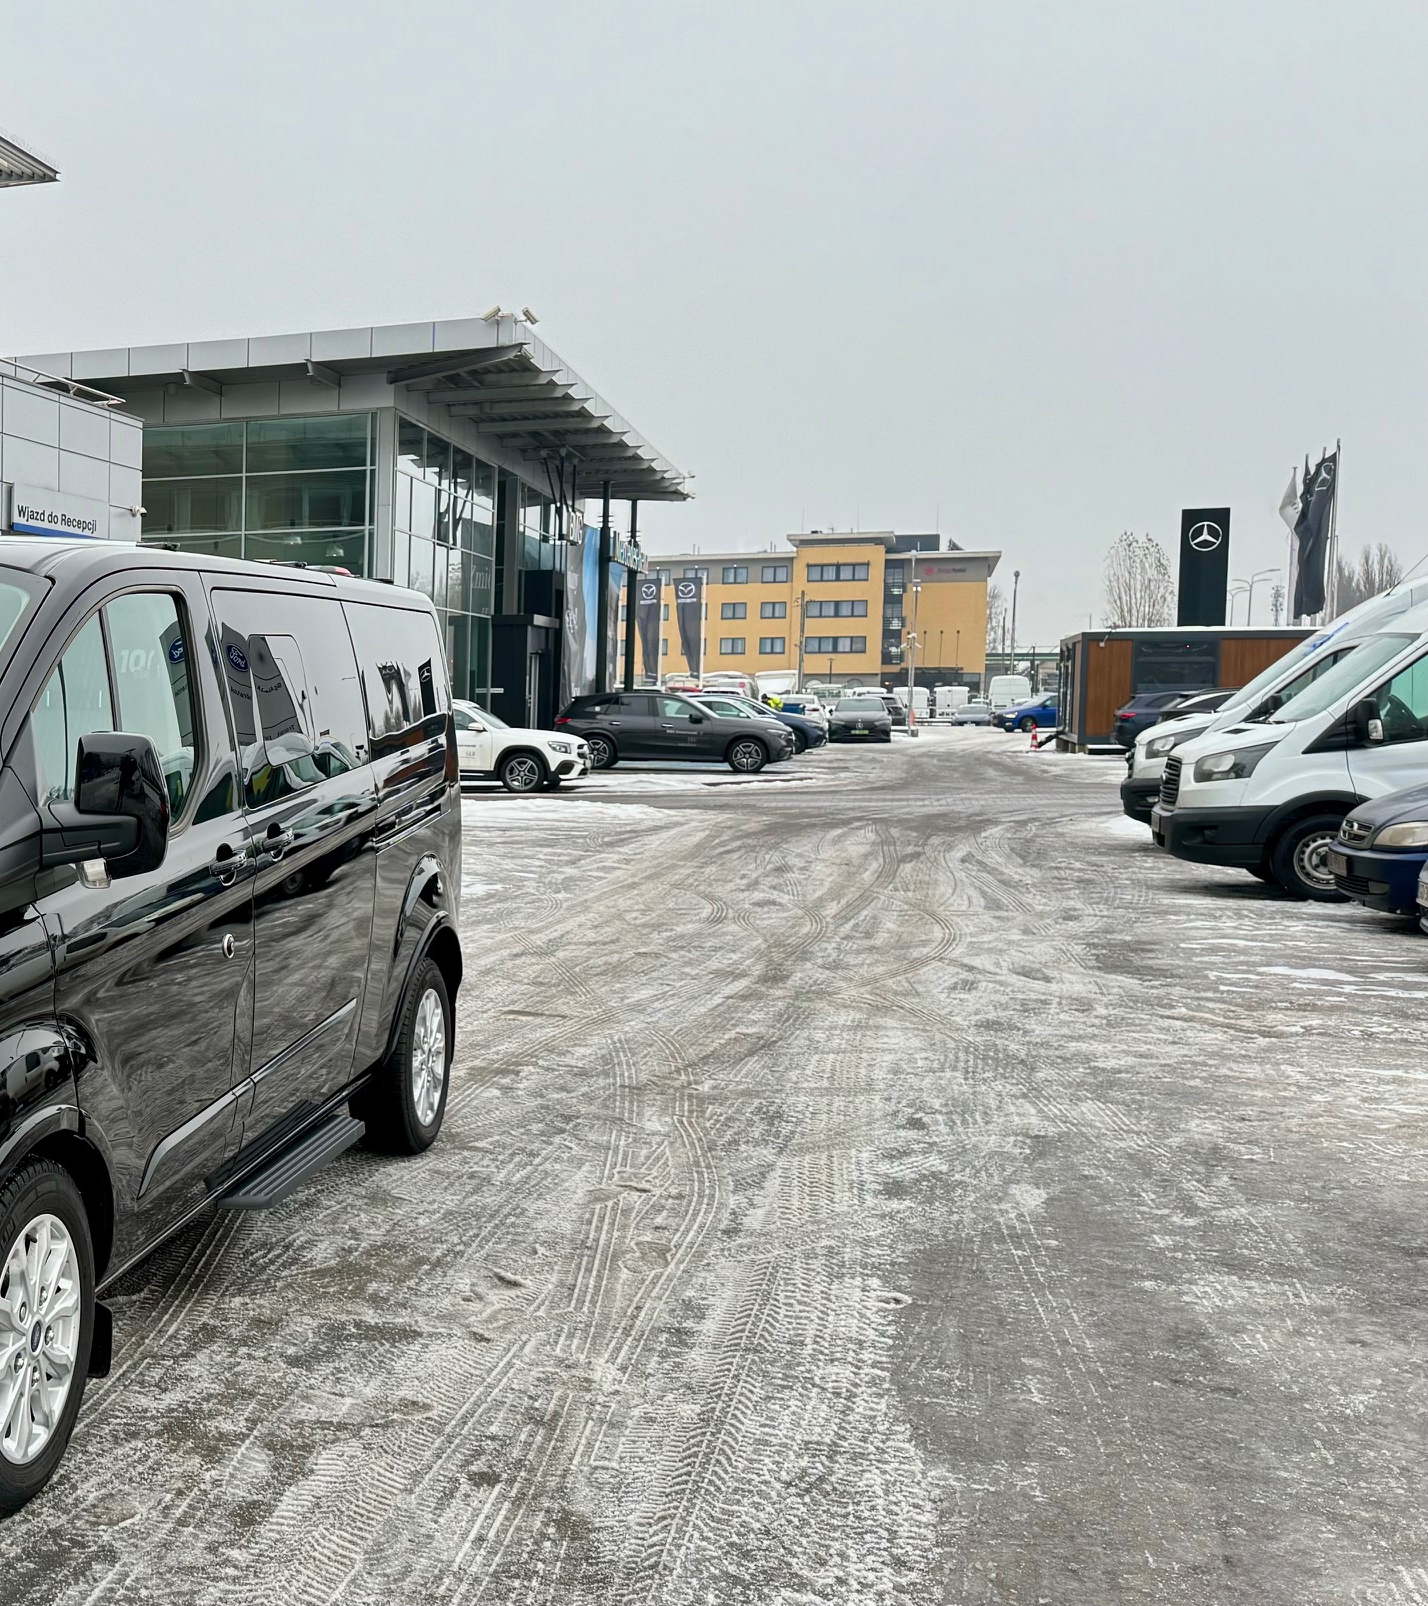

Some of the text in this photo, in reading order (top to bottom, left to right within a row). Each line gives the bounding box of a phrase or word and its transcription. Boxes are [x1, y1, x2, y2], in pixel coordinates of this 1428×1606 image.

[17, 504, 97, 534] Wjazd do Recepcji
